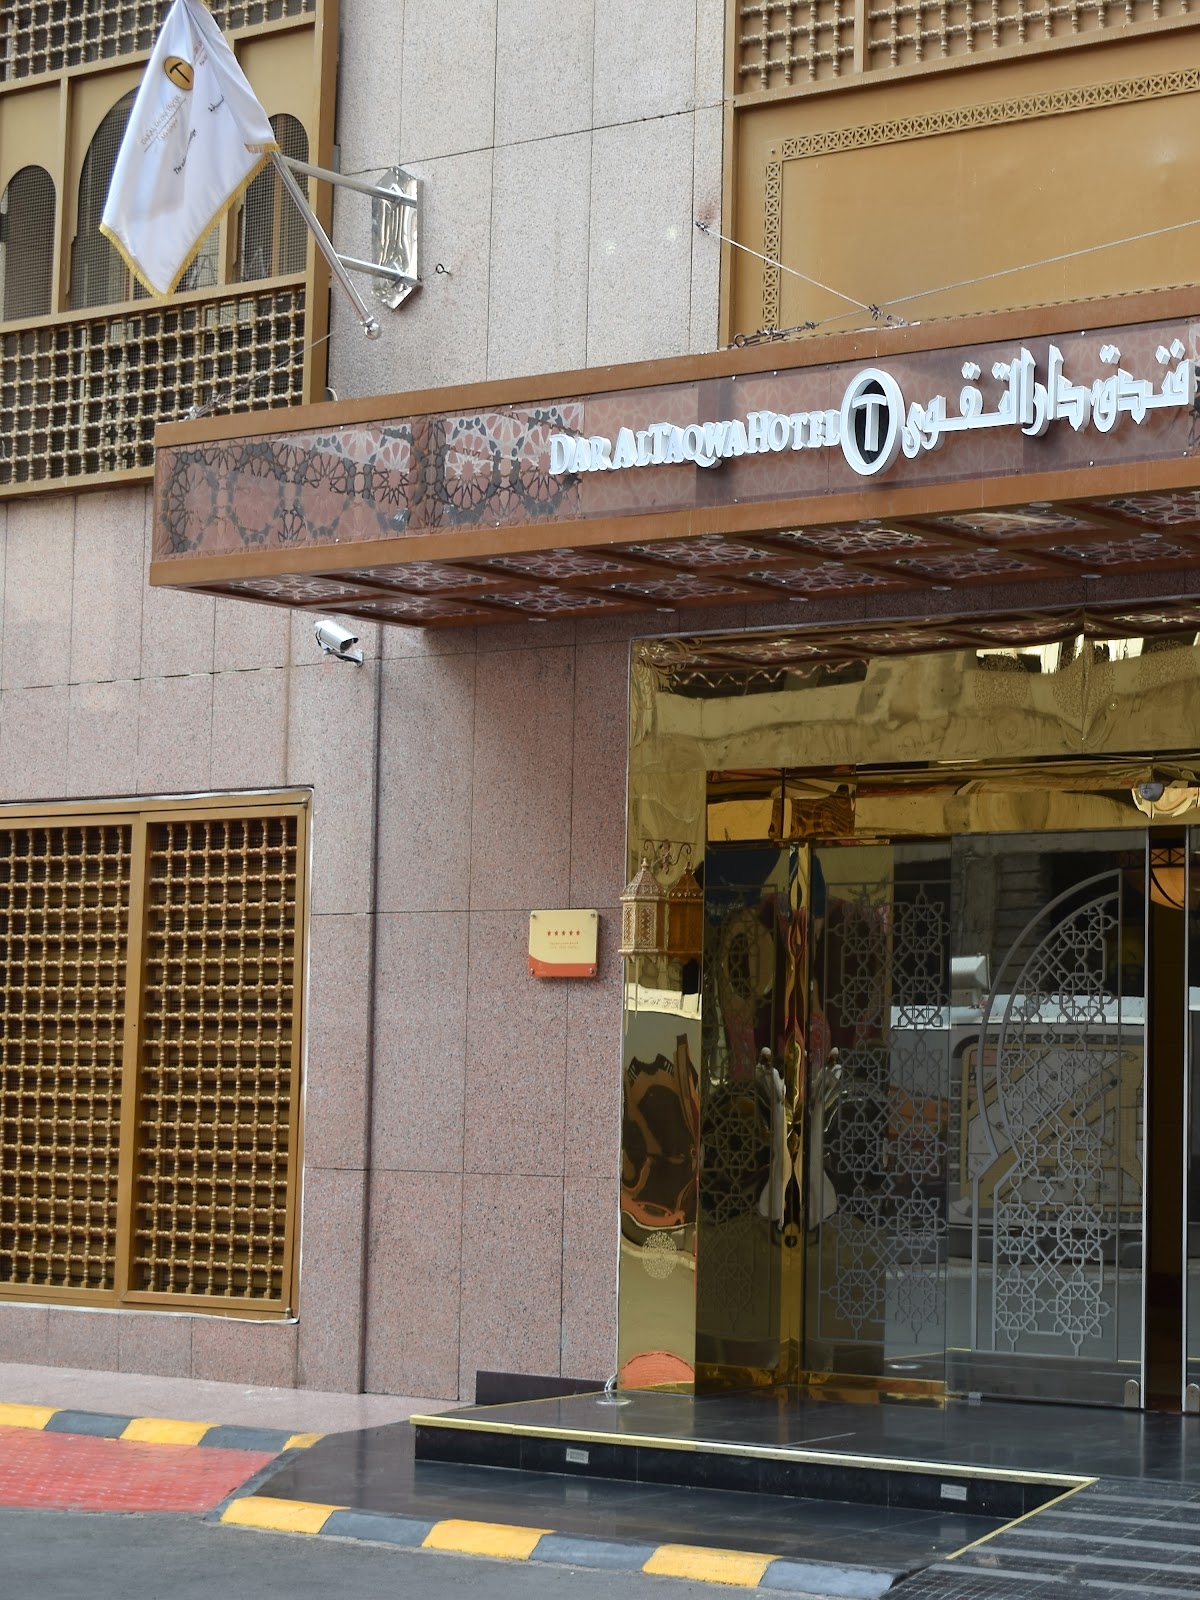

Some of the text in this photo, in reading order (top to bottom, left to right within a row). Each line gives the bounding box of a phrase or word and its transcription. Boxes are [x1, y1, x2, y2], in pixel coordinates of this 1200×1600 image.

[1021, 344, 1091, 436] دار
[1091, 338, 1194, 433] فندق
[549, 432, 612, 475] DAR
[746, 408, 842, 454] HOTEL
